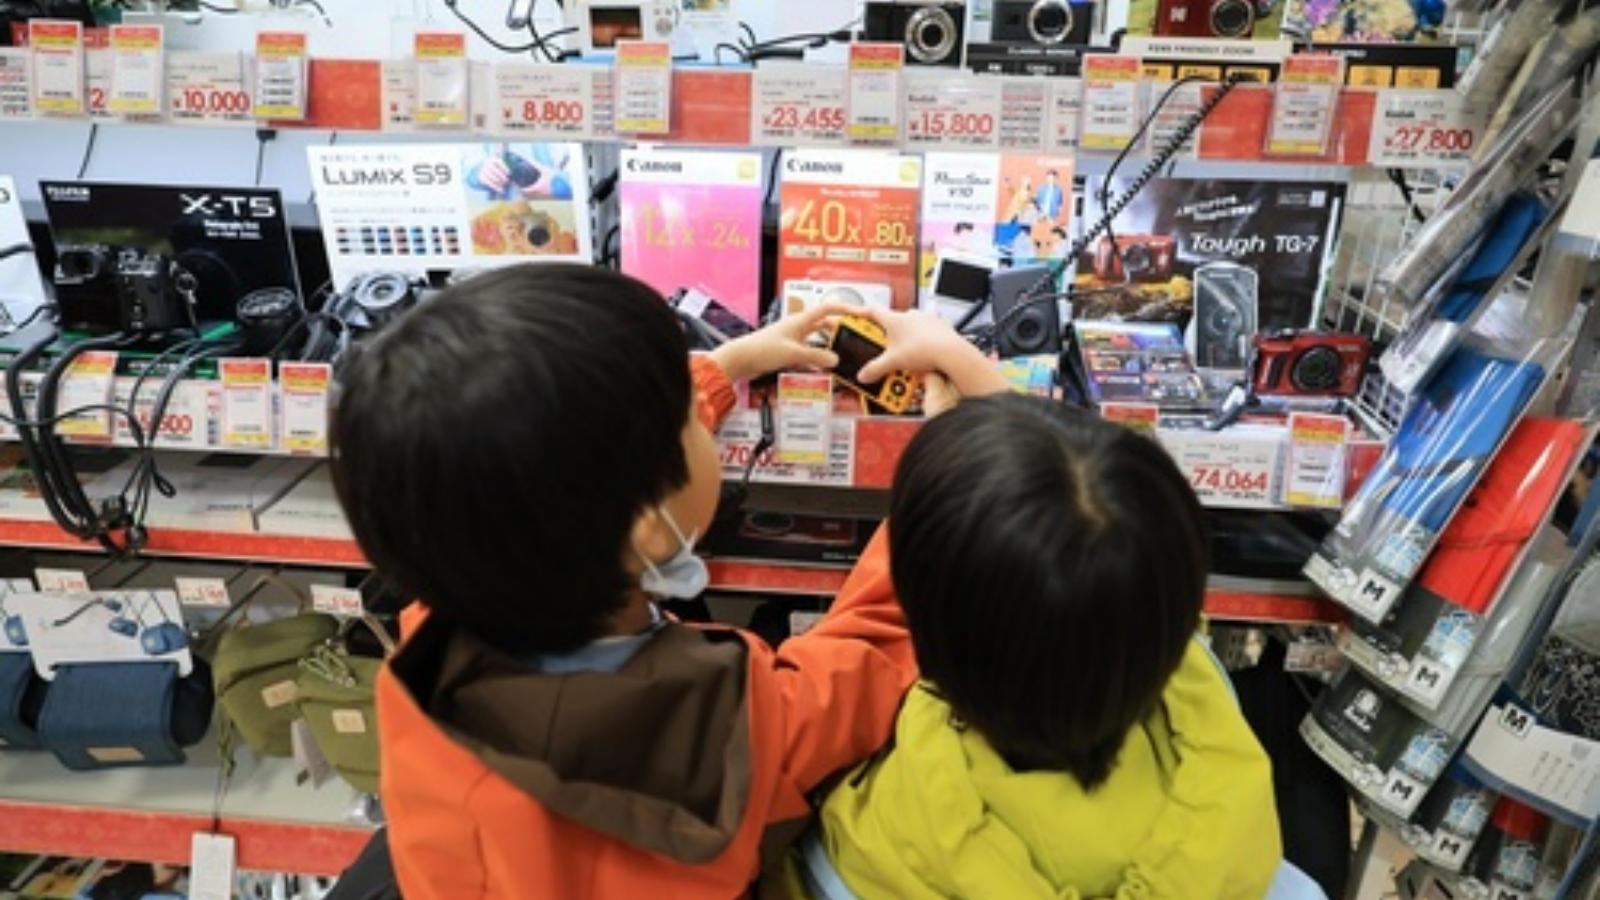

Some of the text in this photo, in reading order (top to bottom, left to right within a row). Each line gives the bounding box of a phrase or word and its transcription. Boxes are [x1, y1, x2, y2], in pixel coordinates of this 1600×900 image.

[522, 101, 584, 124] 8,800
[322, 164, 452, 186] LUMIX S9
[626, 160, 683, 173] Canon
[786, 159, 844, 174] Canon
[180, 193, 277, 218] X-T5
[794, 199, 862, 244] 40x
[1190, 231, 1319, 256] Tough TG-7
[1192, 467, 1268, 492] 74,064
[1362, 579, 1386, 601] M
[1417, 666, 1440, 688] M
[1504, 709, 1528, 732] M
[1391, 781, 1413, 799] M
[1439, 838, 1460, 855] M
